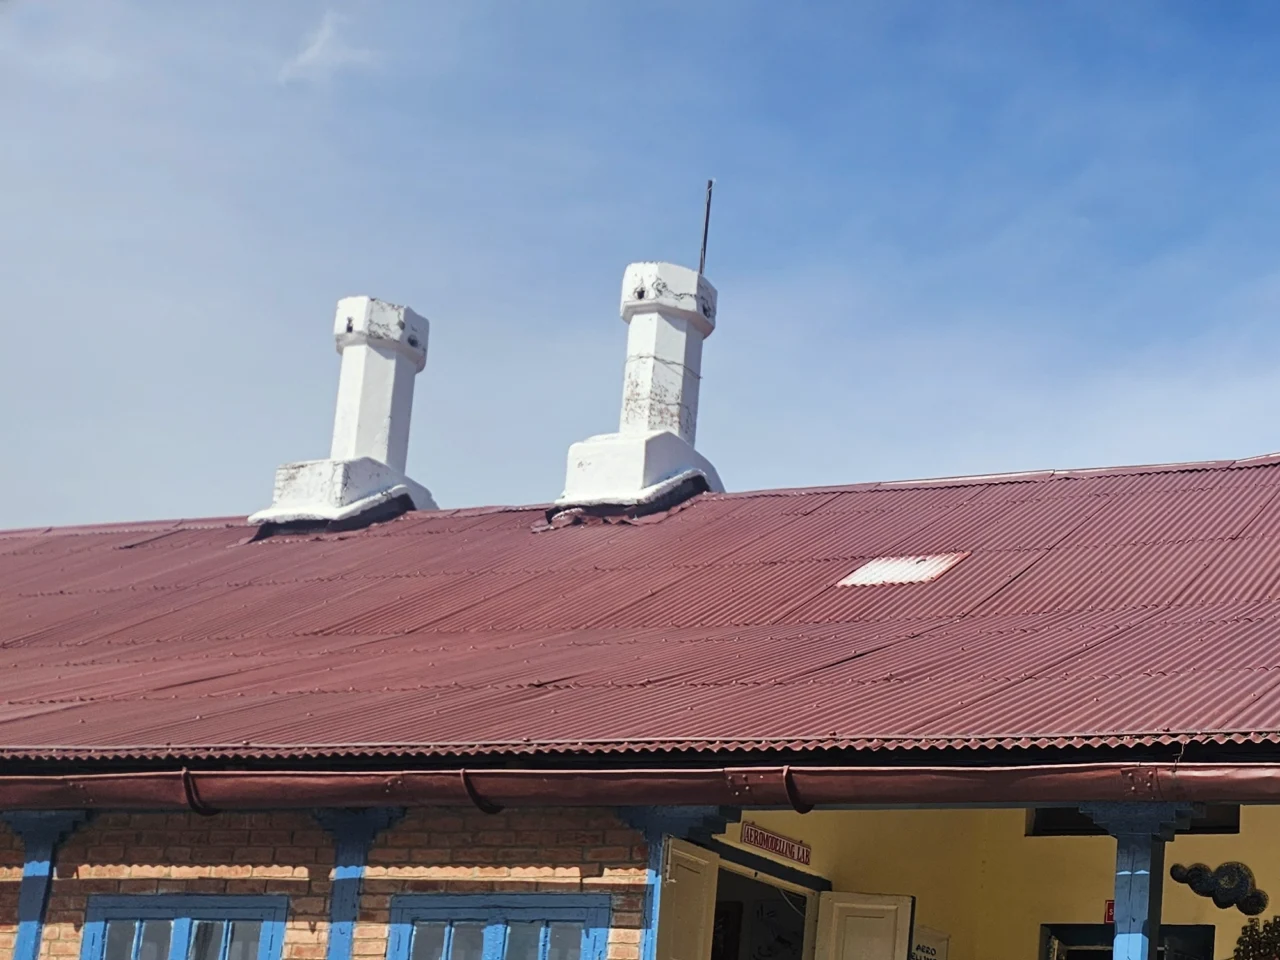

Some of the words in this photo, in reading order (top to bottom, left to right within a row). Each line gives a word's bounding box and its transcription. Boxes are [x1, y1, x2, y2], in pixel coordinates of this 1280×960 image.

[744, 827, 796, 859] AEROMODELLING
[797, 845, 811, 864] LAB
[916, 943, 937, 956] AERO
